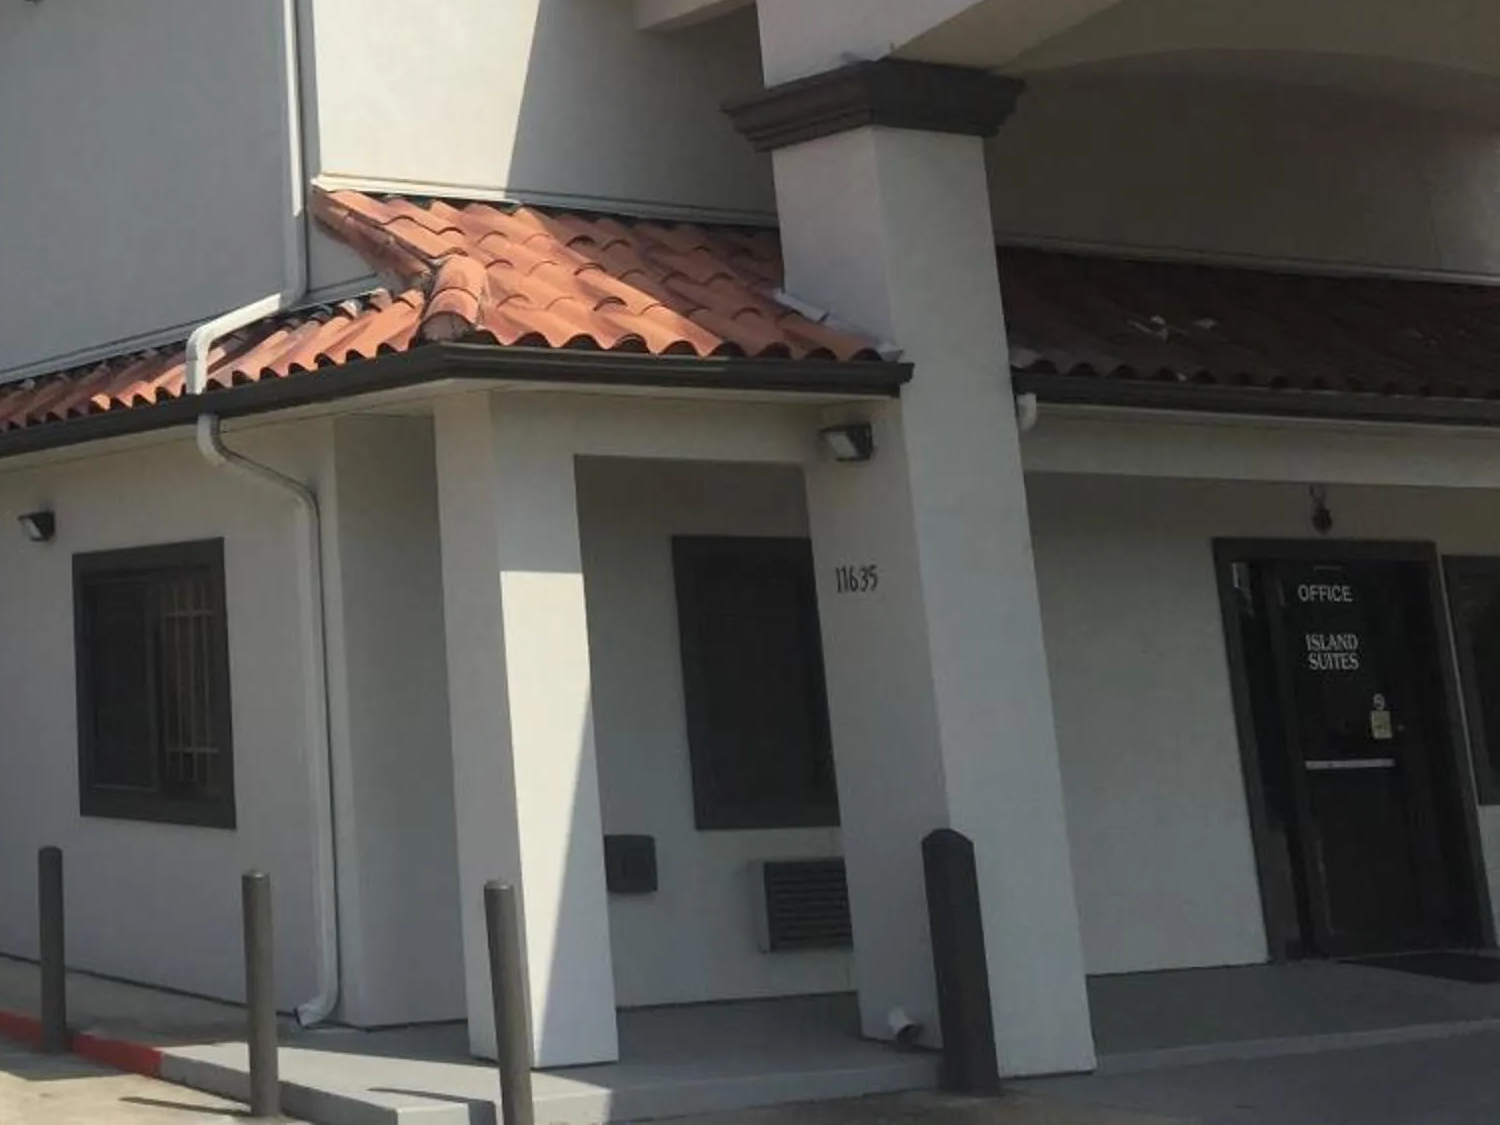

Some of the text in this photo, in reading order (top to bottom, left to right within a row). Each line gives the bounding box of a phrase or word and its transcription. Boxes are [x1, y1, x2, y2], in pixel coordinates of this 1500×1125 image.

[835, 564, 878, 593] 11635
[1298, 584, 1354, 603] OFFICE
[1305, 634, 1359, 651] ISLAND
[1307, 652, 1360, 671] SUITES
